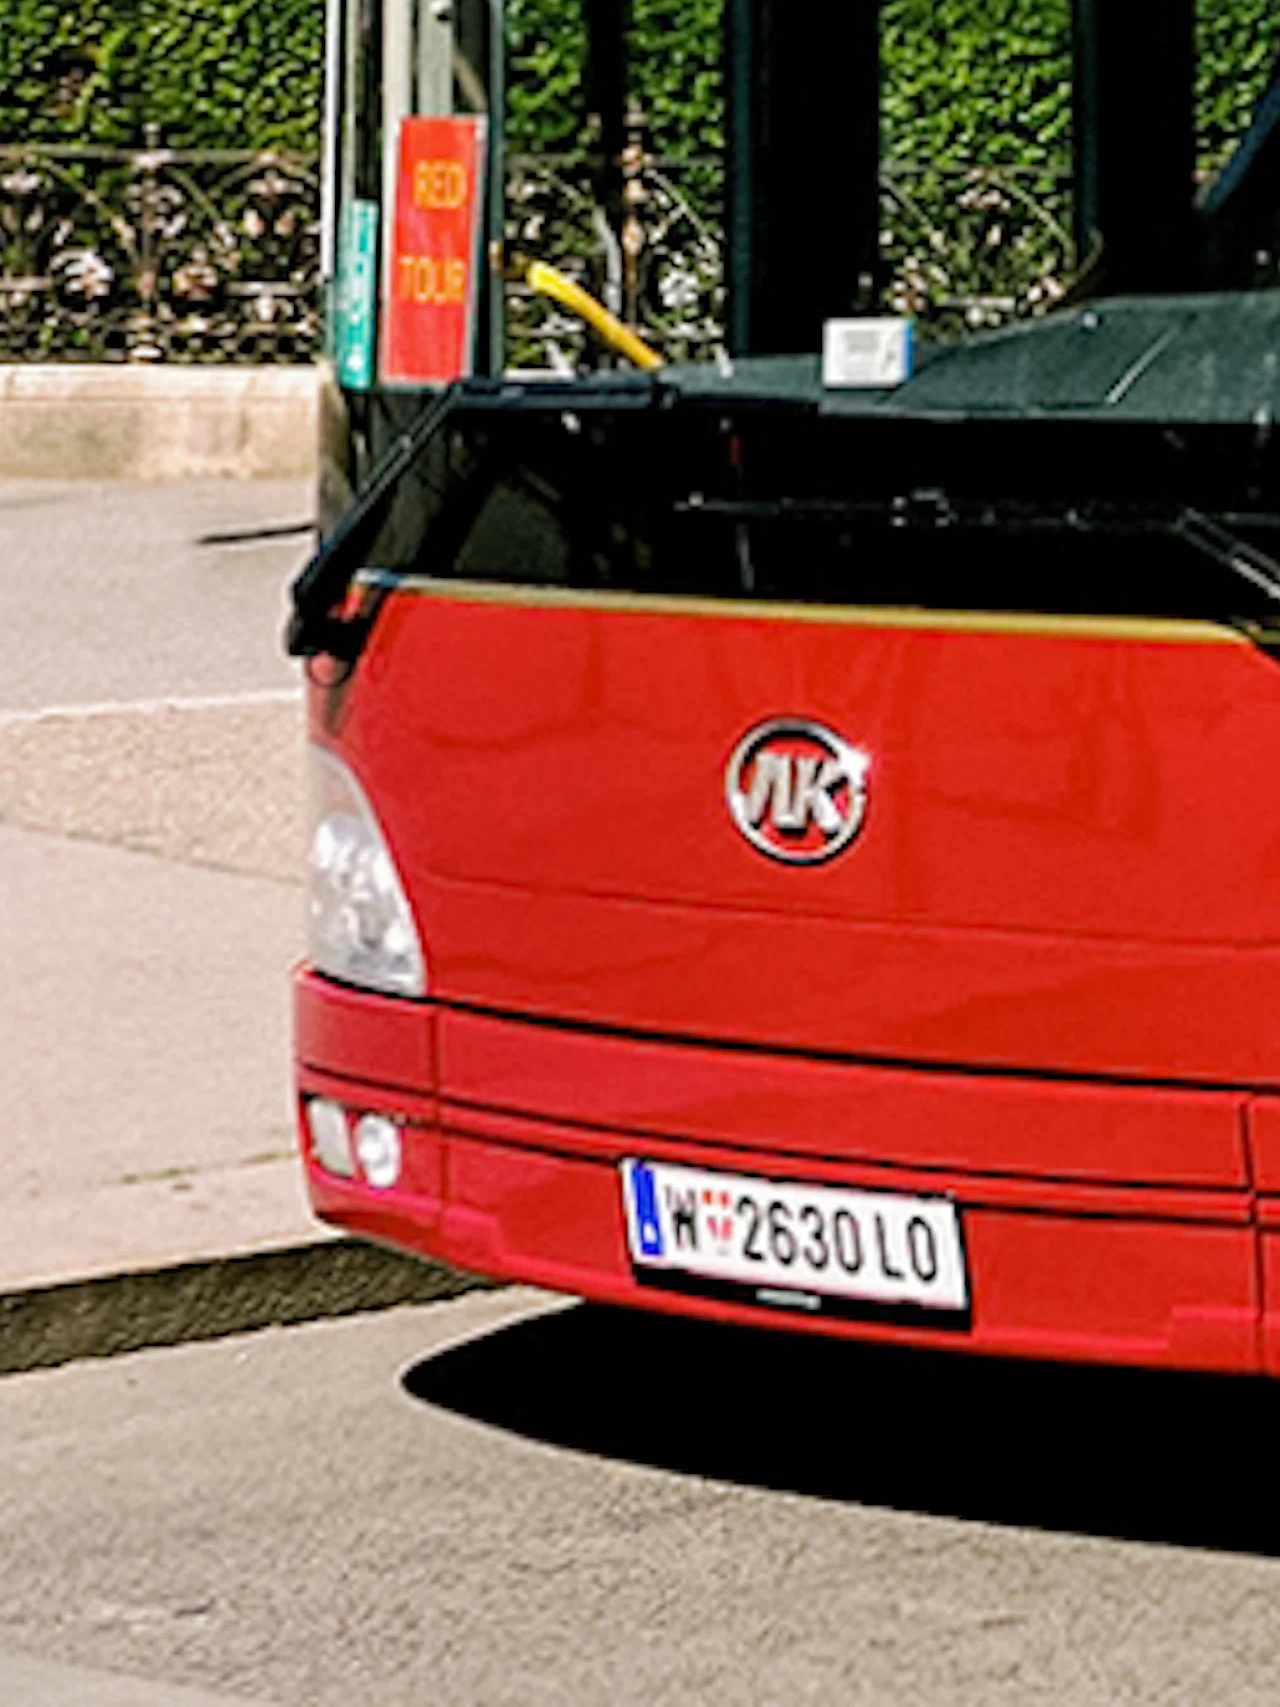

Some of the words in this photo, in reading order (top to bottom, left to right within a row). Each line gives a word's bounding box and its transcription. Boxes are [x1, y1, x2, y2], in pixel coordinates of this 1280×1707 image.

[413, 159, 467, 208] RED
[399, 255, 466, 304] TOUR
[664, 1185, 697, 1250] W
[737, 1196, 861, 1272] 2630
